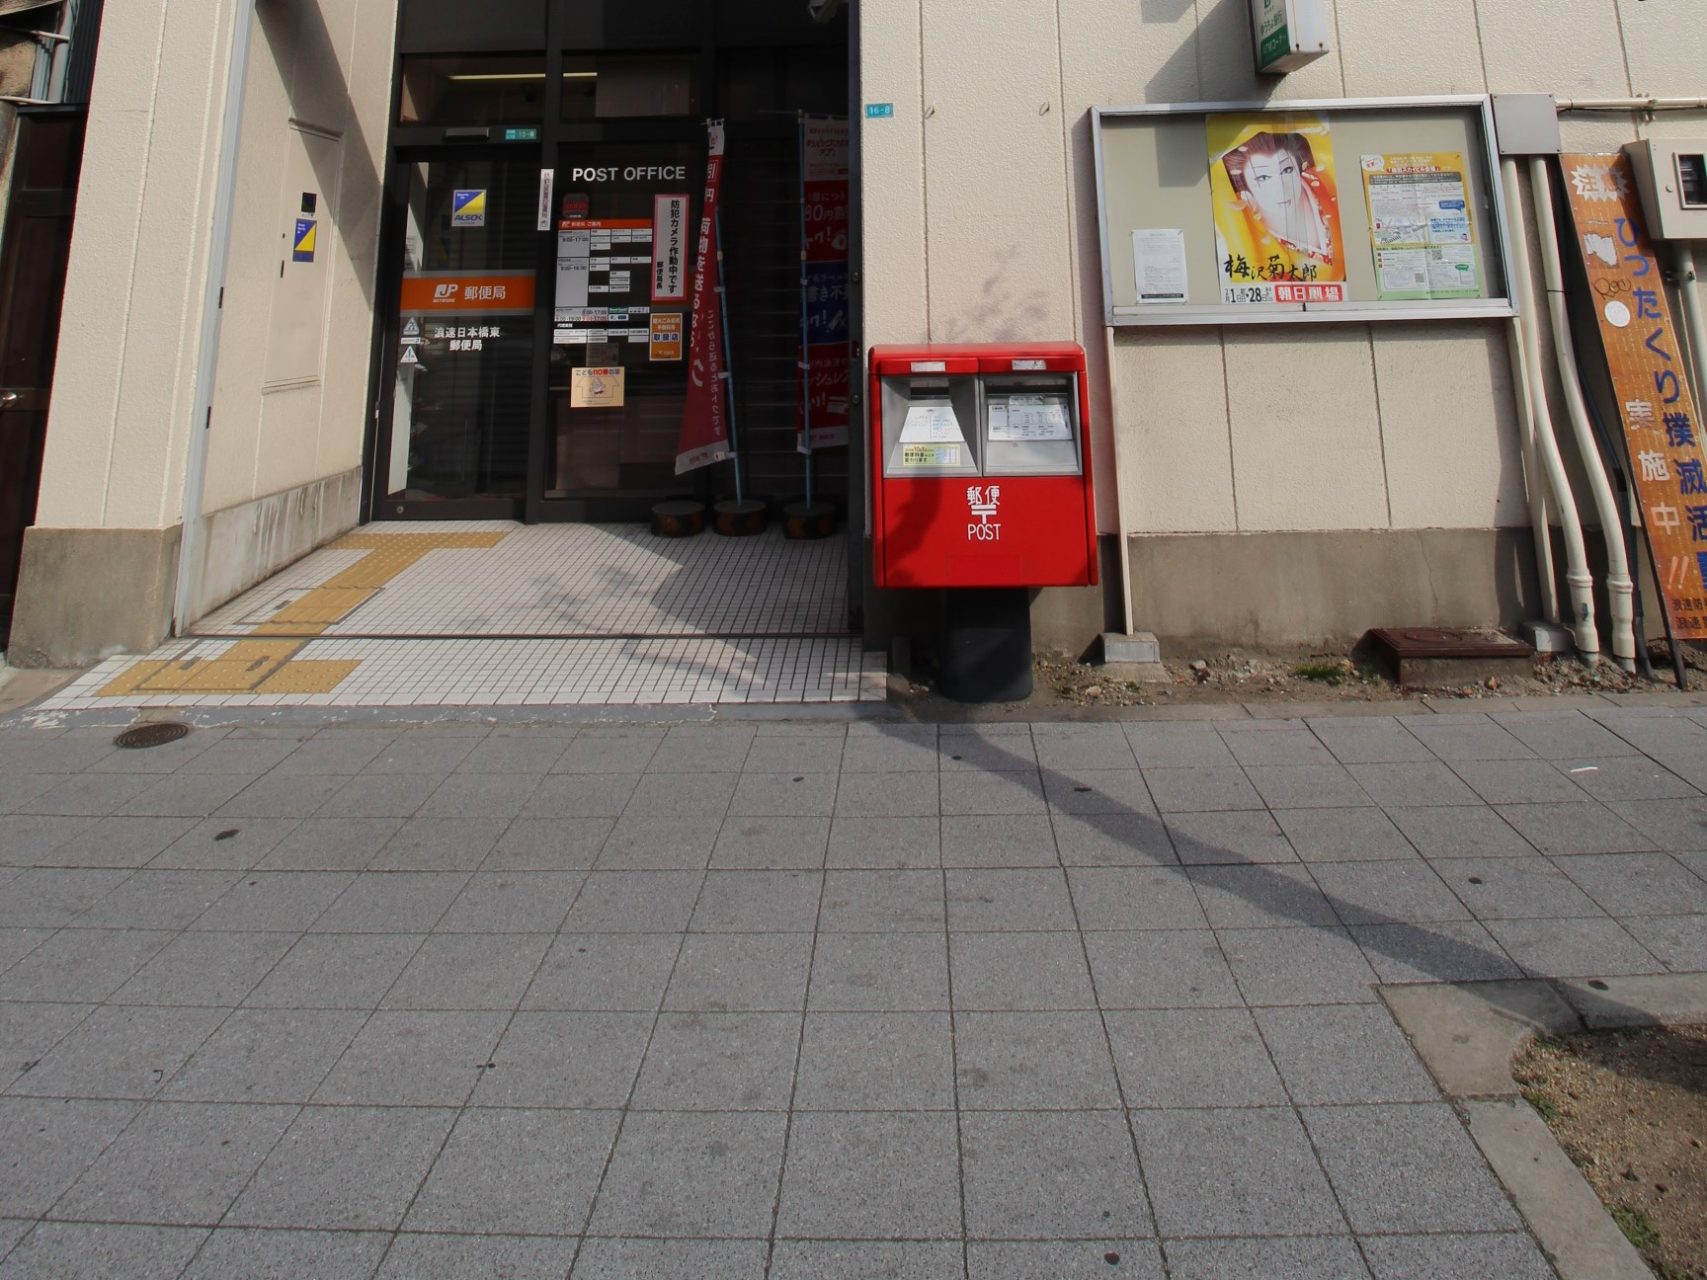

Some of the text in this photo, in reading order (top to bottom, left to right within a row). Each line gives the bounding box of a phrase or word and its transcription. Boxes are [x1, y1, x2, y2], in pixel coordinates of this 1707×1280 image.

[869, 106, 890, 115] 16-8
[572, 166, 686, 182] POST OFFICE
[454, 214, 484, 222] ALSOK
[668, 199, 681, 294] 防犯カメラ作動中です
[655, 261, 664, 289] 郵便局長
[464, 285, 506, 301] 郵便局
[1278, 285, 1340, 301] 朝日劇場
[434, 326, 501, 339] 浪速日本橋東
[449, 339, 483, 351] 郵便局
[967, 485, 1001, 506] 郵便
[967, 523, 1001, 541] POST
[1671, 598, 1707, 611] 浪速防
[1675, 616, 1707, 629] 浪速
